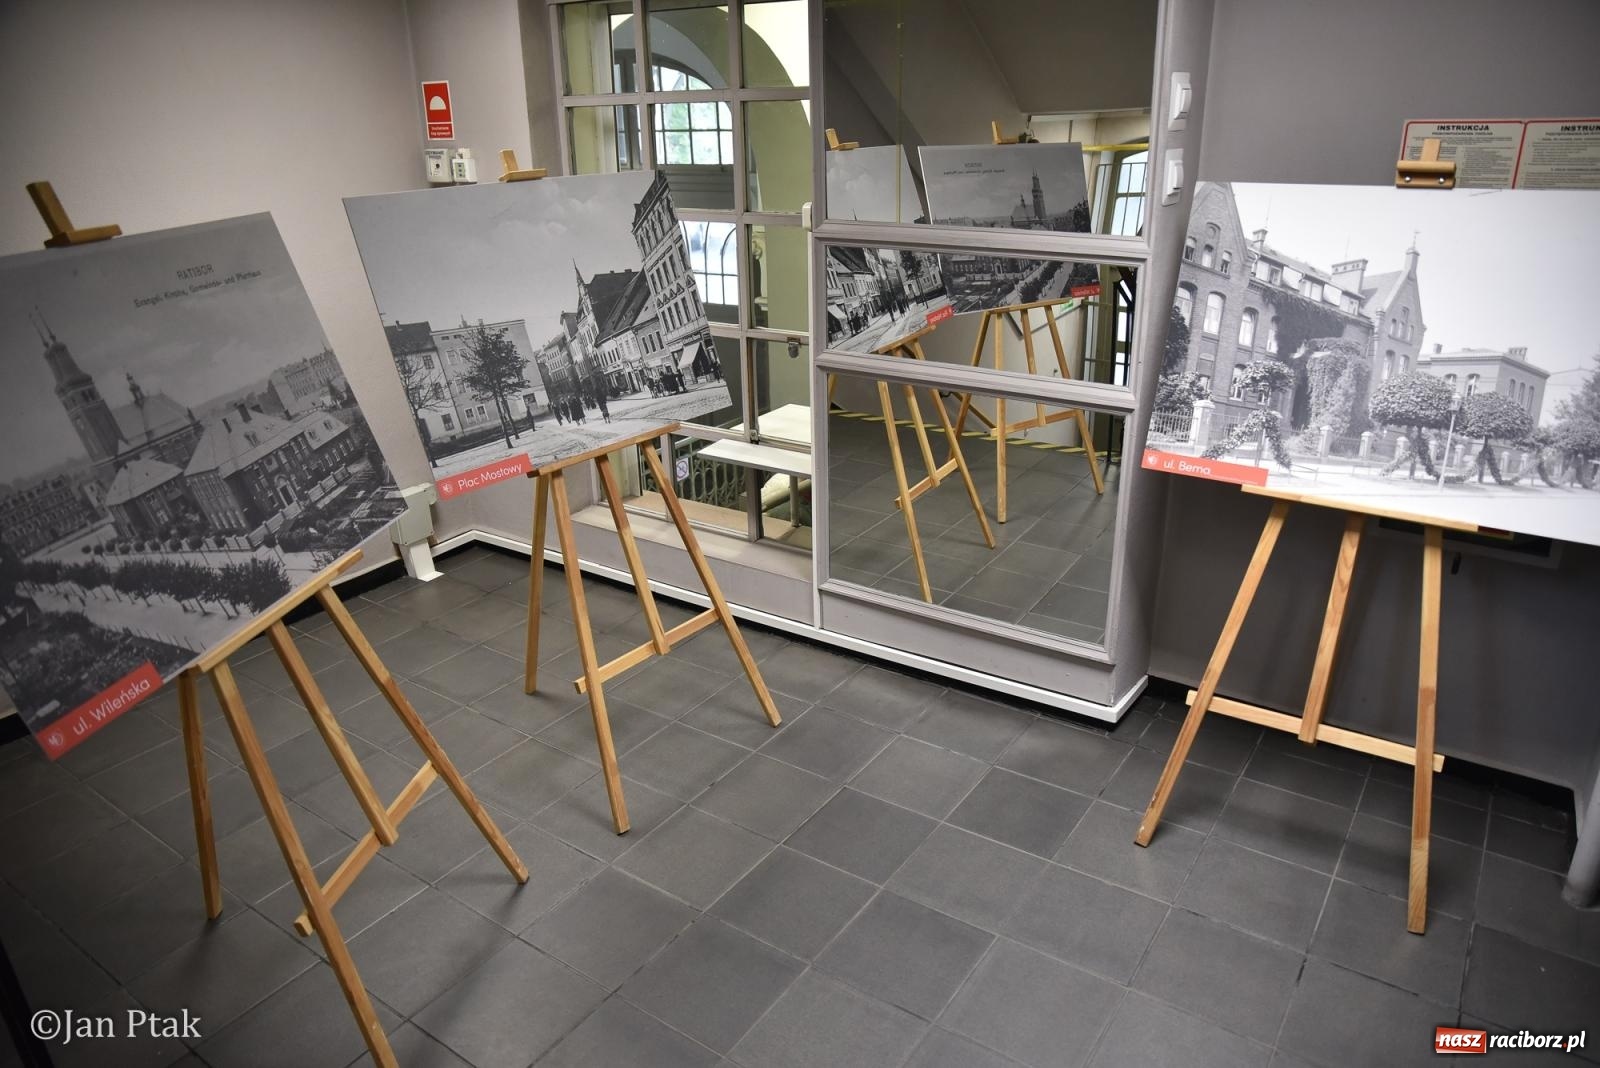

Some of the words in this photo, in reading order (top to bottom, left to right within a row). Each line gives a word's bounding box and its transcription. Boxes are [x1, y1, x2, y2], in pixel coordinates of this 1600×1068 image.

[1436, 124, 1490, 132] INSTRUKCJA
[1163, 459, 1175, 470] ul.
[457, 478, 480, 491] Plac
[480, 463, 522, 484] Mostowy
[73, 716, 92, 735] ul.
[89, 679, 151, 721] Wileńska
